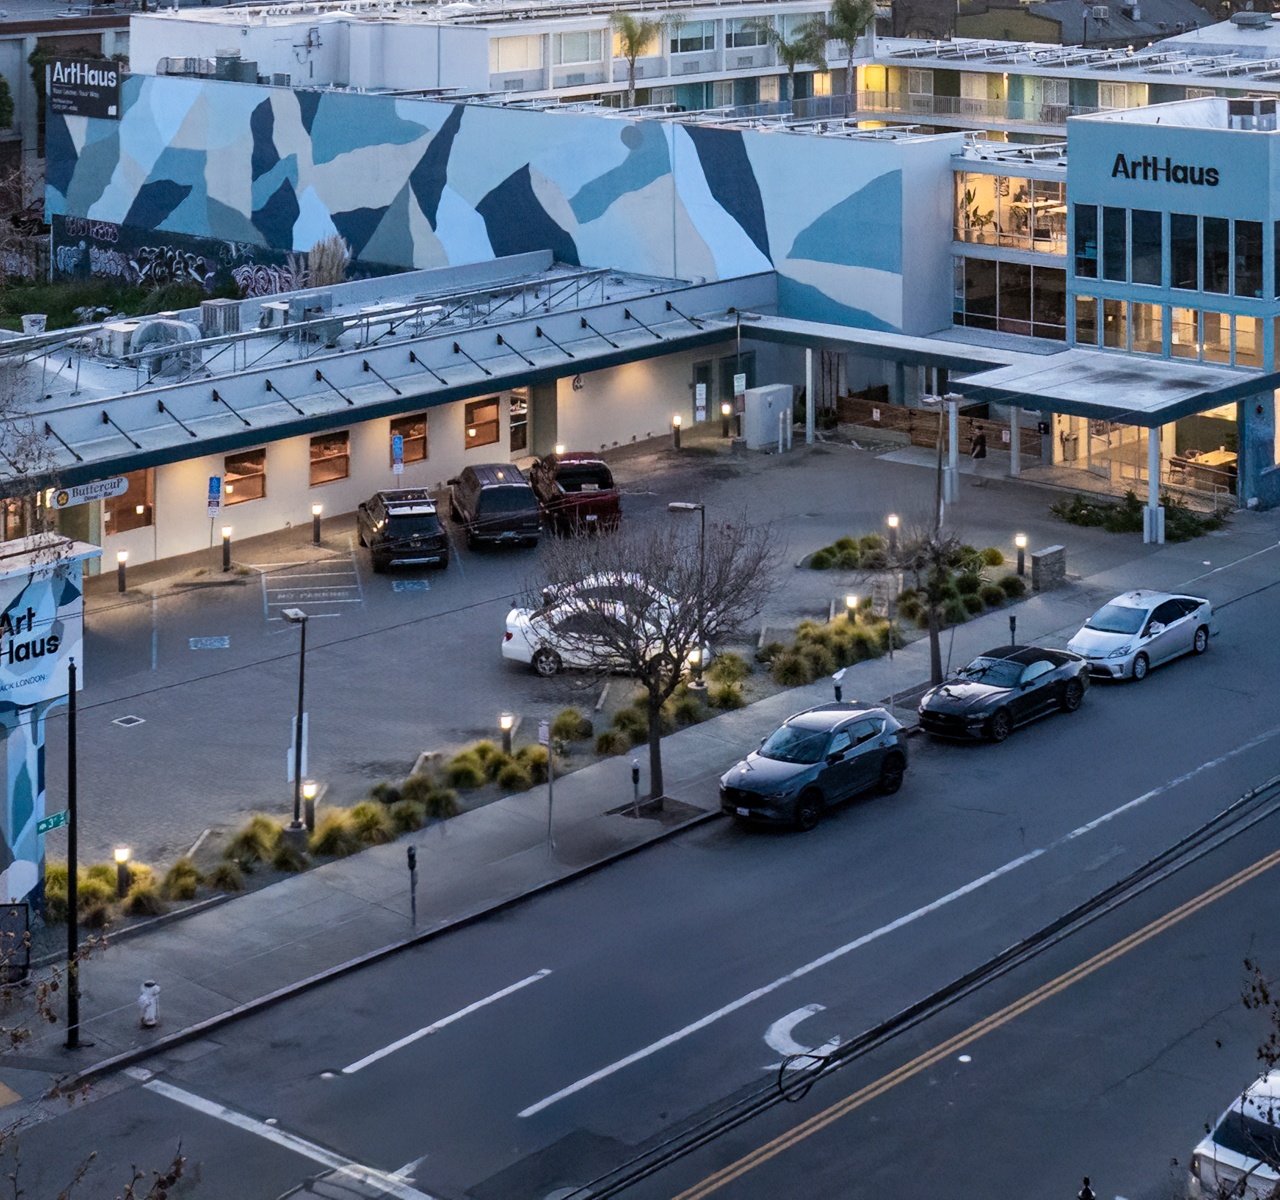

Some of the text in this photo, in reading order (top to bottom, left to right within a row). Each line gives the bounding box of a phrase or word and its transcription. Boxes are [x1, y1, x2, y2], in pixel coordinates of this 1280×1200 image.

[52, 61, 117, 88] ArtHaus
[1111, 153, 1219, 187] ArtHaus
[16, 674, 46, 688] LONDON
